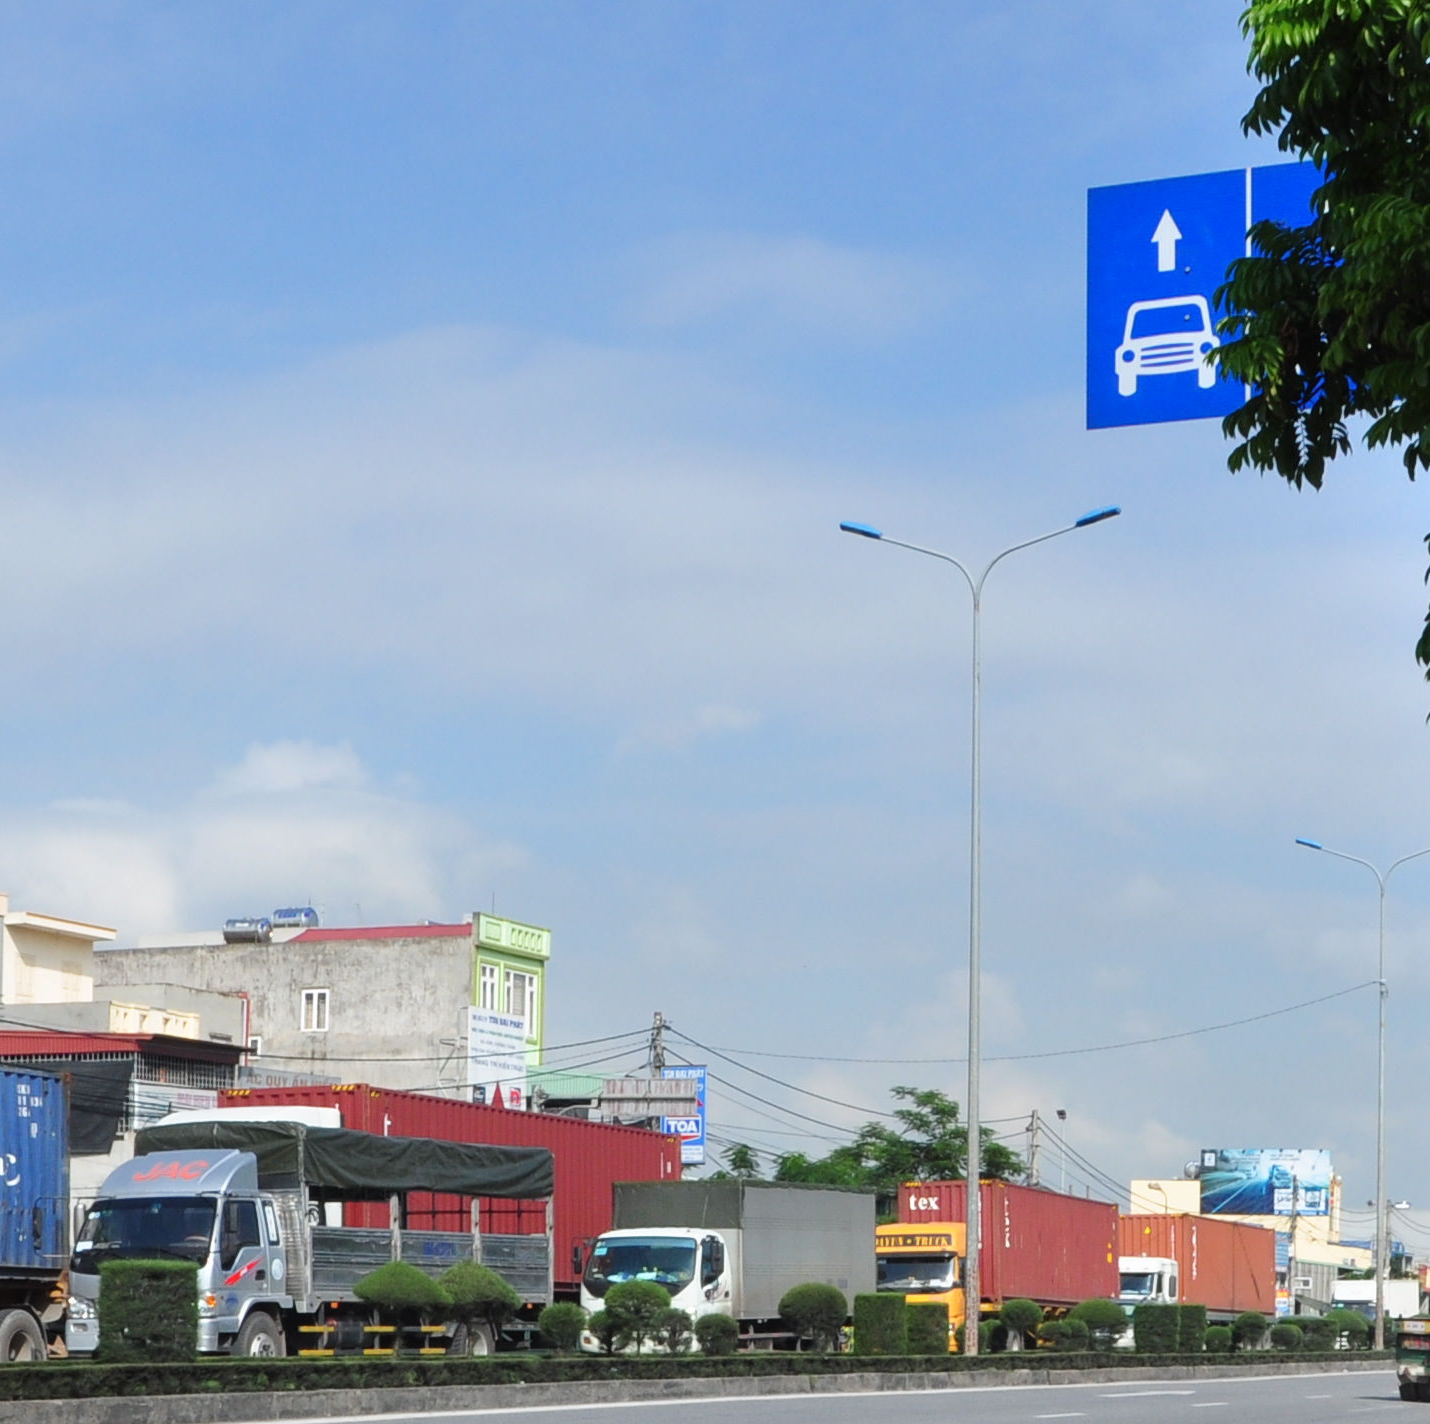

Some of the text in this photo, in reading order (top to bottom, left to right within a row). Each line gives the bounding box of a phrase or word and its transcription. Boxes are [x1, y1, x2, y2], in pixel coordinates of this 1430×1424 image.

[667, 1120, 698, 1133] TOA
[133, 1159, 209, 1182] JAC
[909, 1193, 940, 1211] tex
